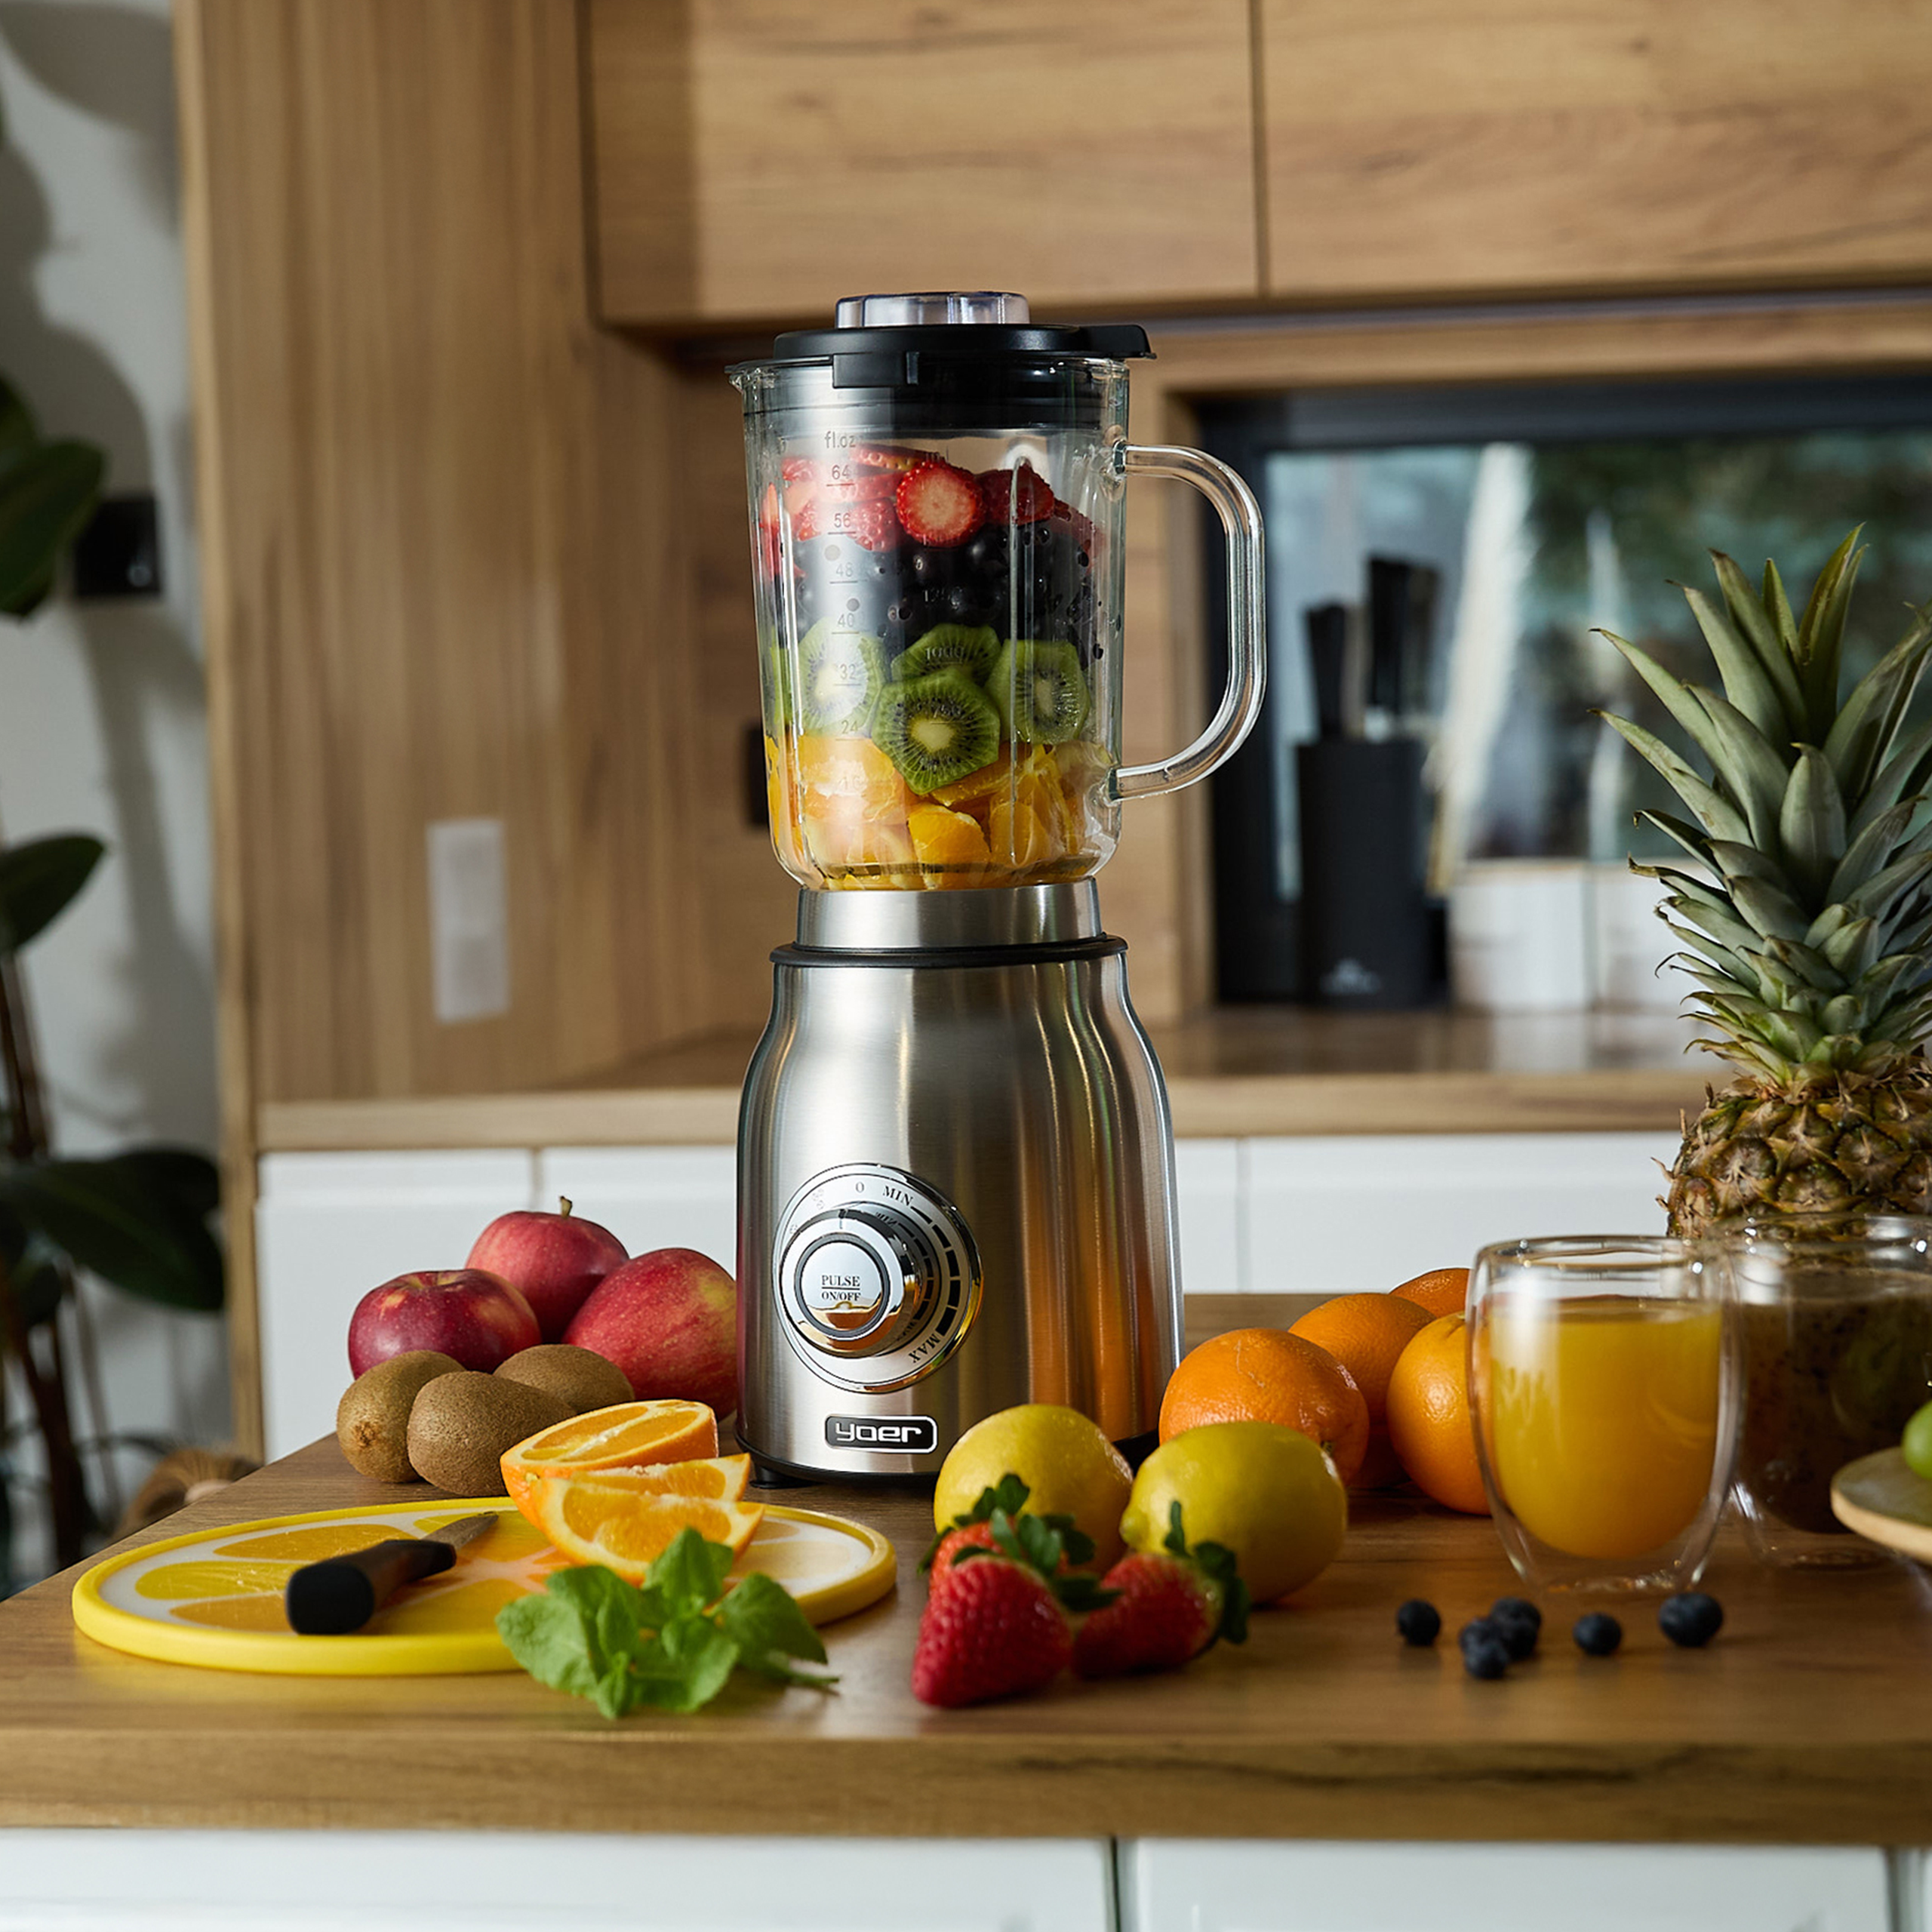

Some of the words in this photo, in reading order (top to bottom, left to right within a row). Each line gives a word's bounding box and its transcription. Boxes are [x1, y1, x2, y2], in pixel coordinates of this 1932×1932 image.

[825, 431, 857, 448] fl.oz
[832, 465, 851, 479] 64
[833, 512, 851, 528] 56
[835, 562, 853, 577] 48
[837, 613, 854, 628] 40
[839, 663, 857, 679] 32
[841, 720, 858, 734] 24
[882, 1185, 914, 1206] MIN
[821, 1275, 860, 1287] PULSE
[821, 1291, 861, 1301] ON/OFF
[908, 1333, 941, 1364] MAX
